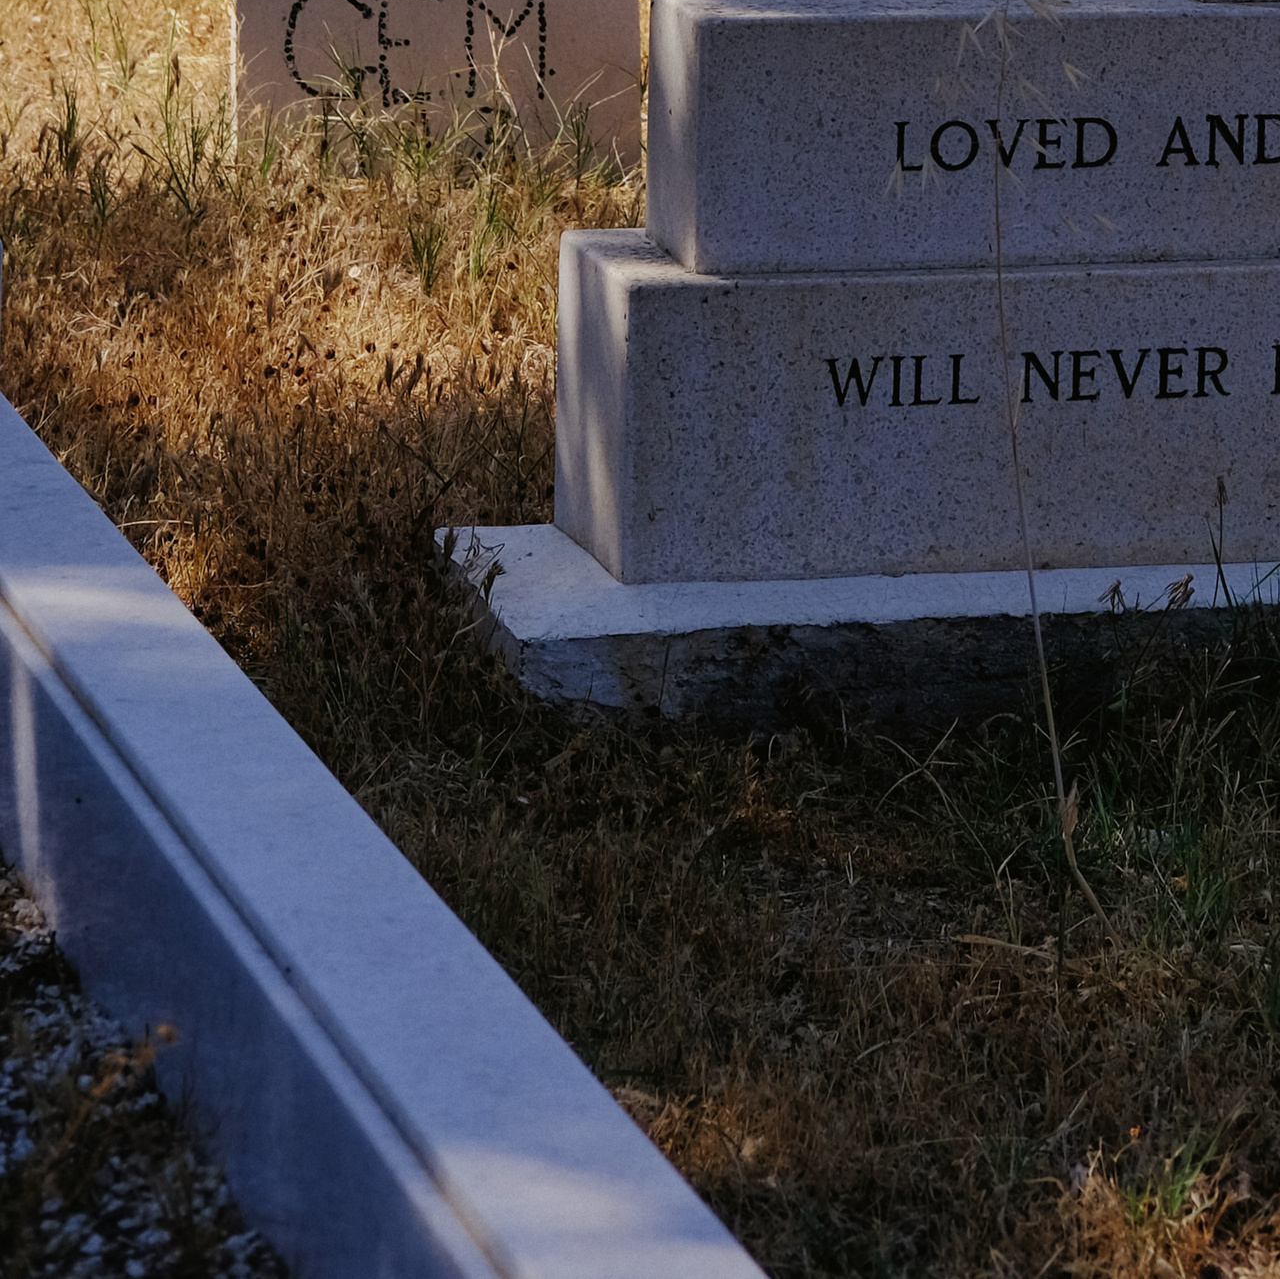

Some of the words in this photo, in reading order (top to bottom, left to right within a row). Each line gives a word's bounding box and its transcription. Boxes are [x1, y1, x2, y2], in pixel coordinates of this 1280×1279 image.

[893, 116, 1119, 172] LOVED
[824, 352, 980, 408] WILL
[1020, 343, 1232, 404] NEVER
